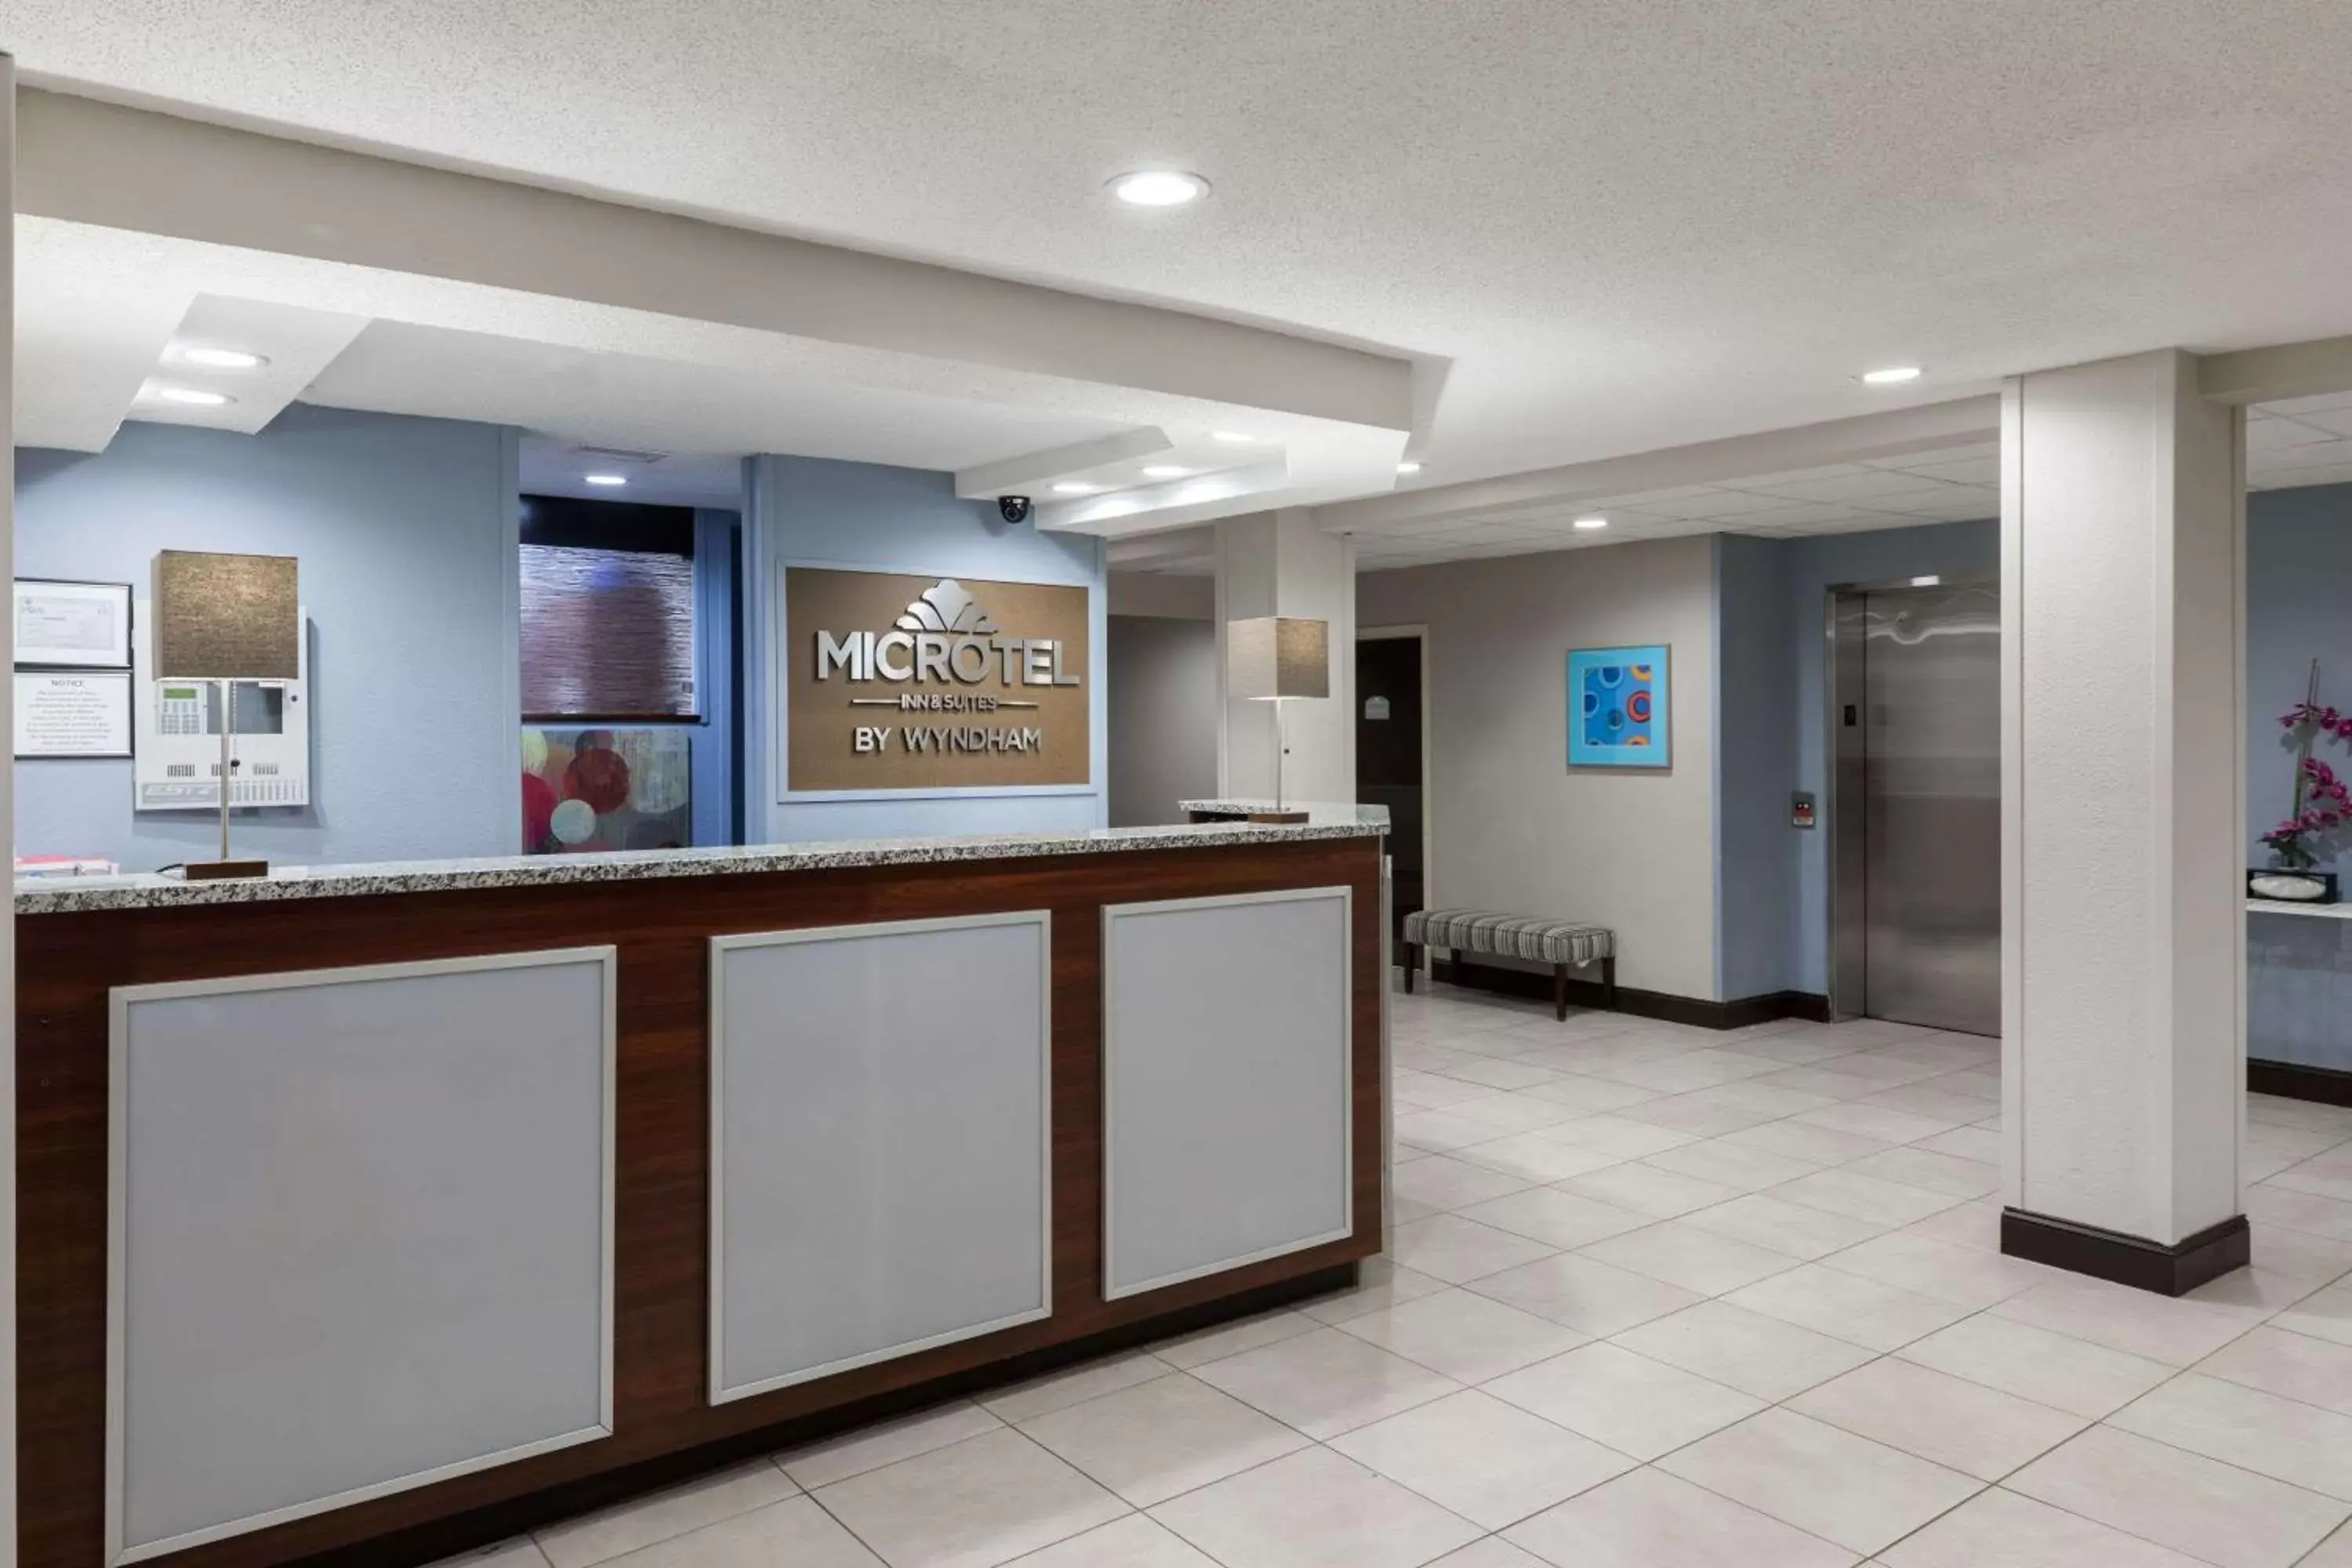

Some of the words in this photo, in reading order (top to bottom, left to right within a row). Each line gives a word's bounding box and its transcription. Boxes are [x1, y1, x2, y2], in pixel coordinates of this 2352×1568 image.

[815, 630, 1080, 687] MICROTEL
[855, 727, 891, 752] BY
[903, 727, 1042, 752] WYNDHAM
